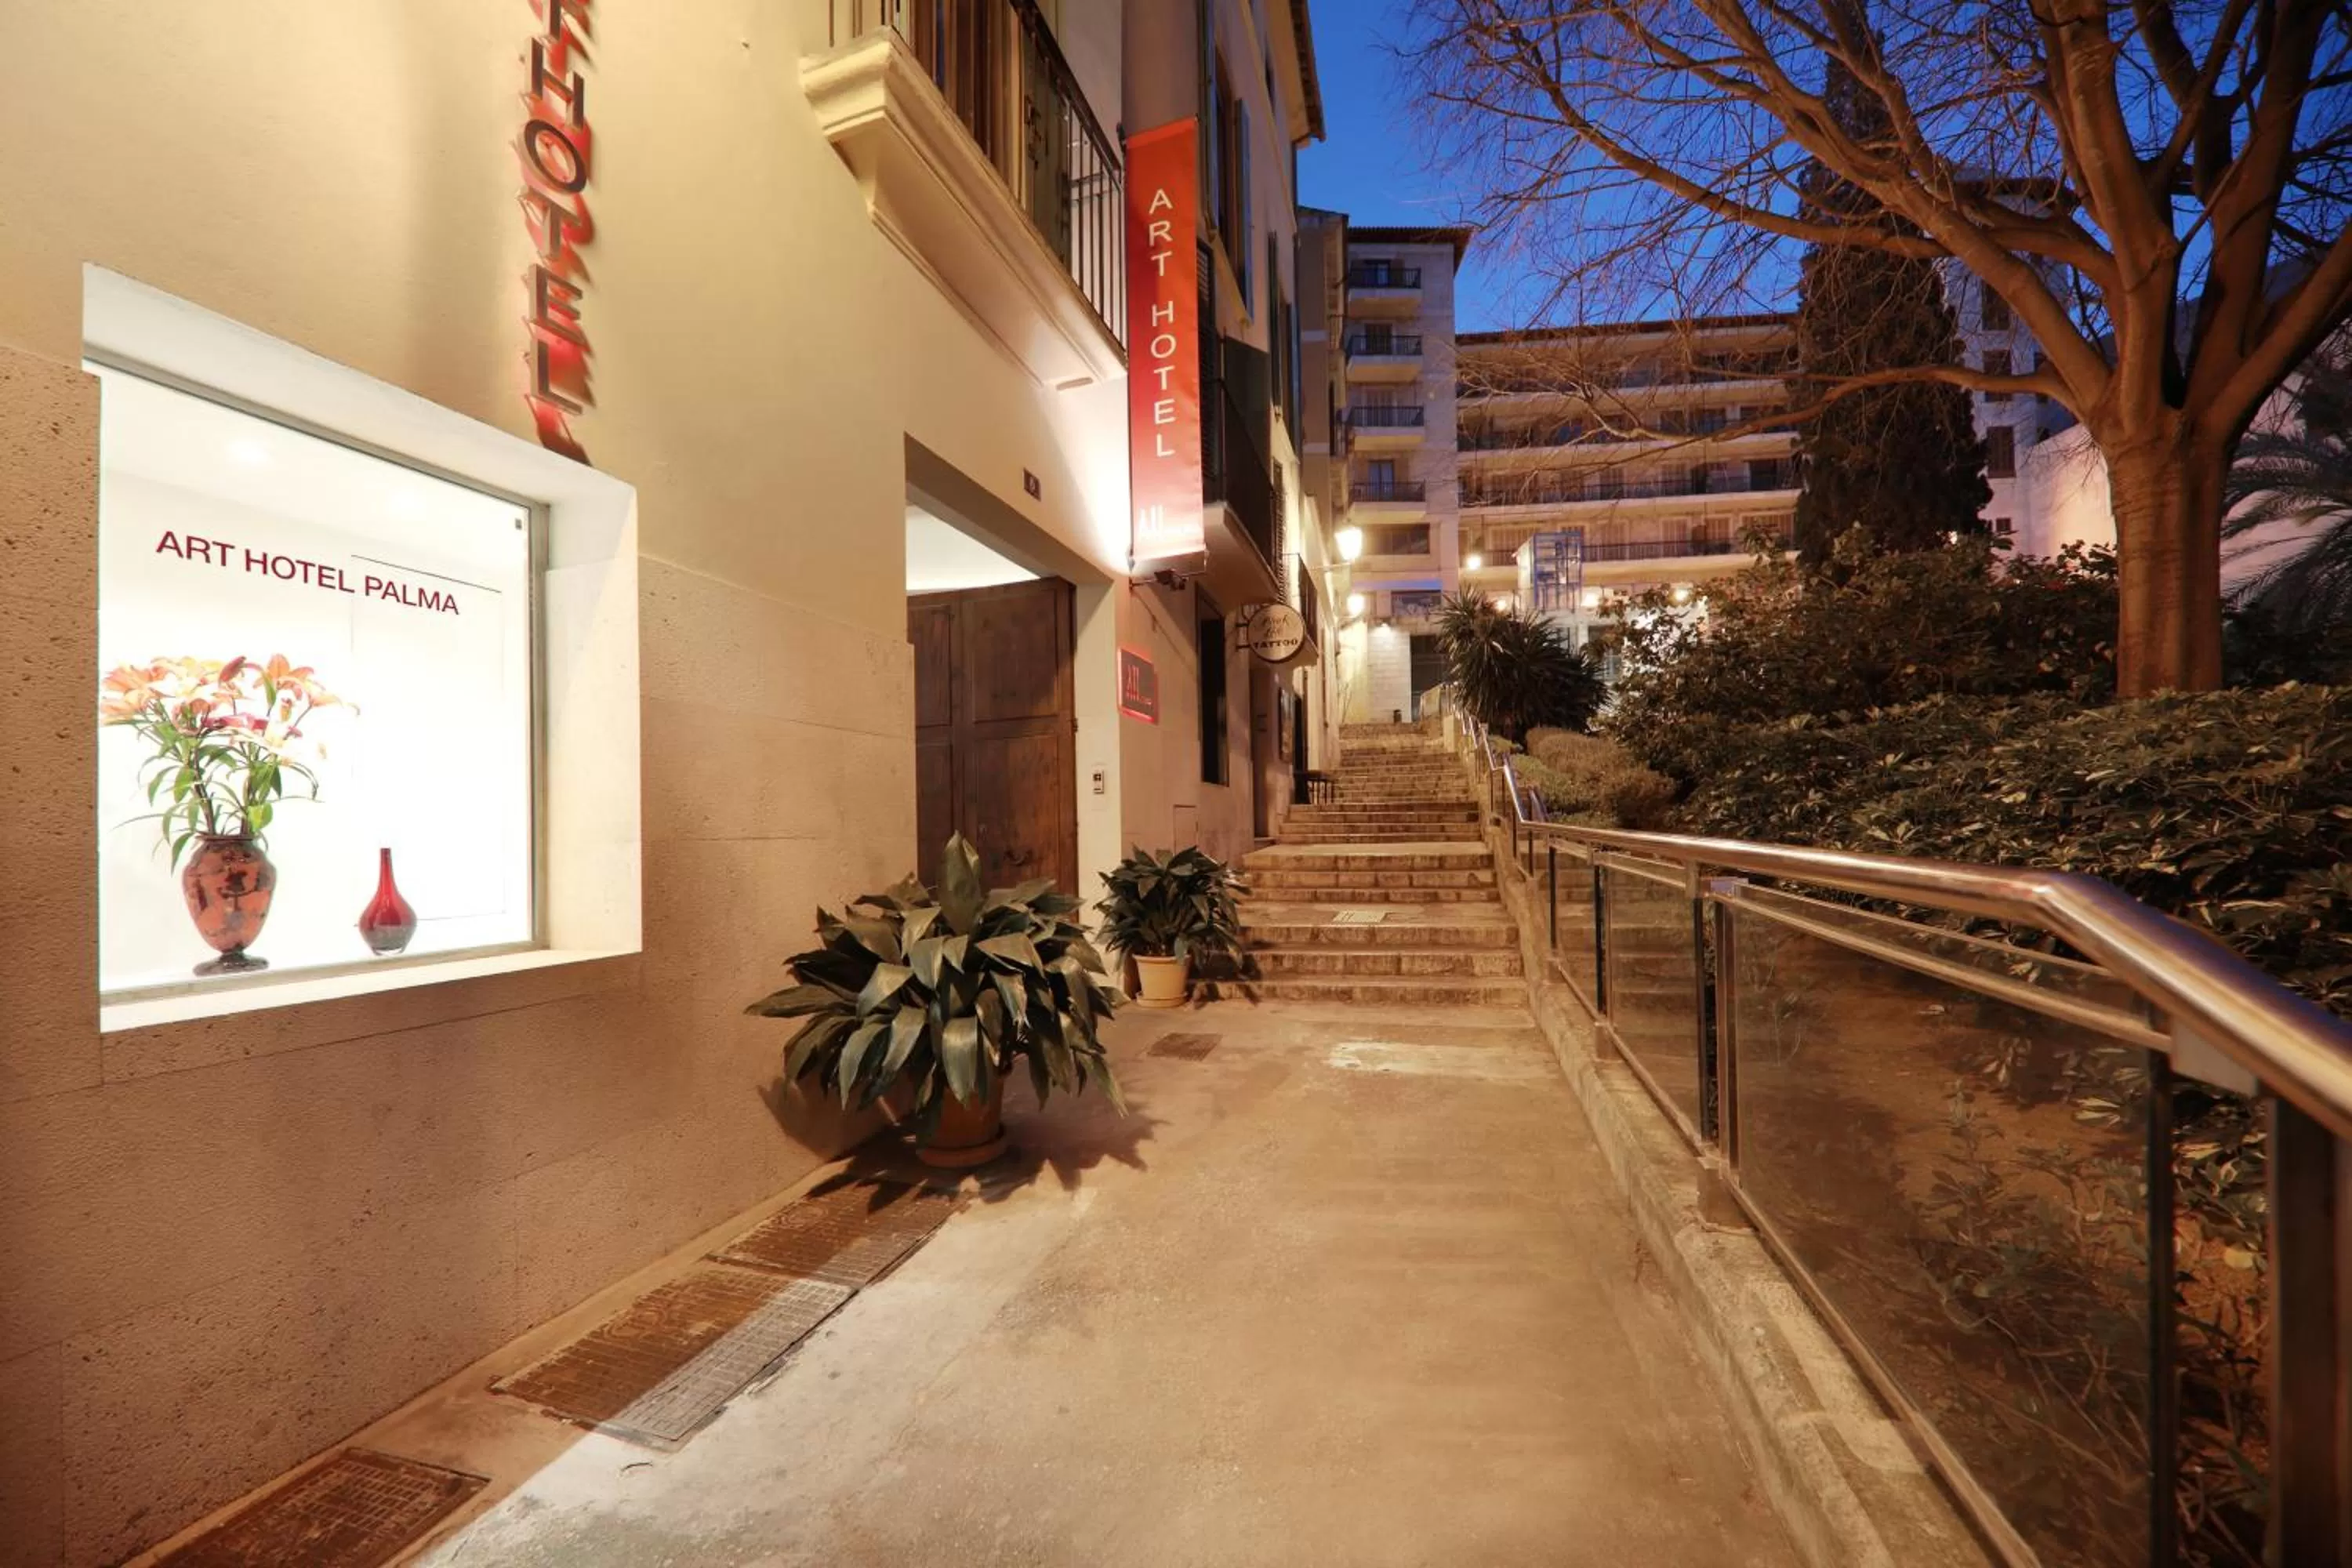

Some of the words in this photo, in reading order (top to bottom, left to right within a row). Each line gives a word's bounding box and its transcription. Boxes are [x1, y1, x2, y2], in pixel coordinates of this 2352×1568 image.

[1149, 188, 1174, 277] ART
[1151, 300, 1177, 458] HOTEL
[156, 531, 235, 568] ART
[245, 549, 354, 593] HOTEL
[365, 575, 459, 615] PALMA
[1254, 638, 1298, 648] TATTOO
